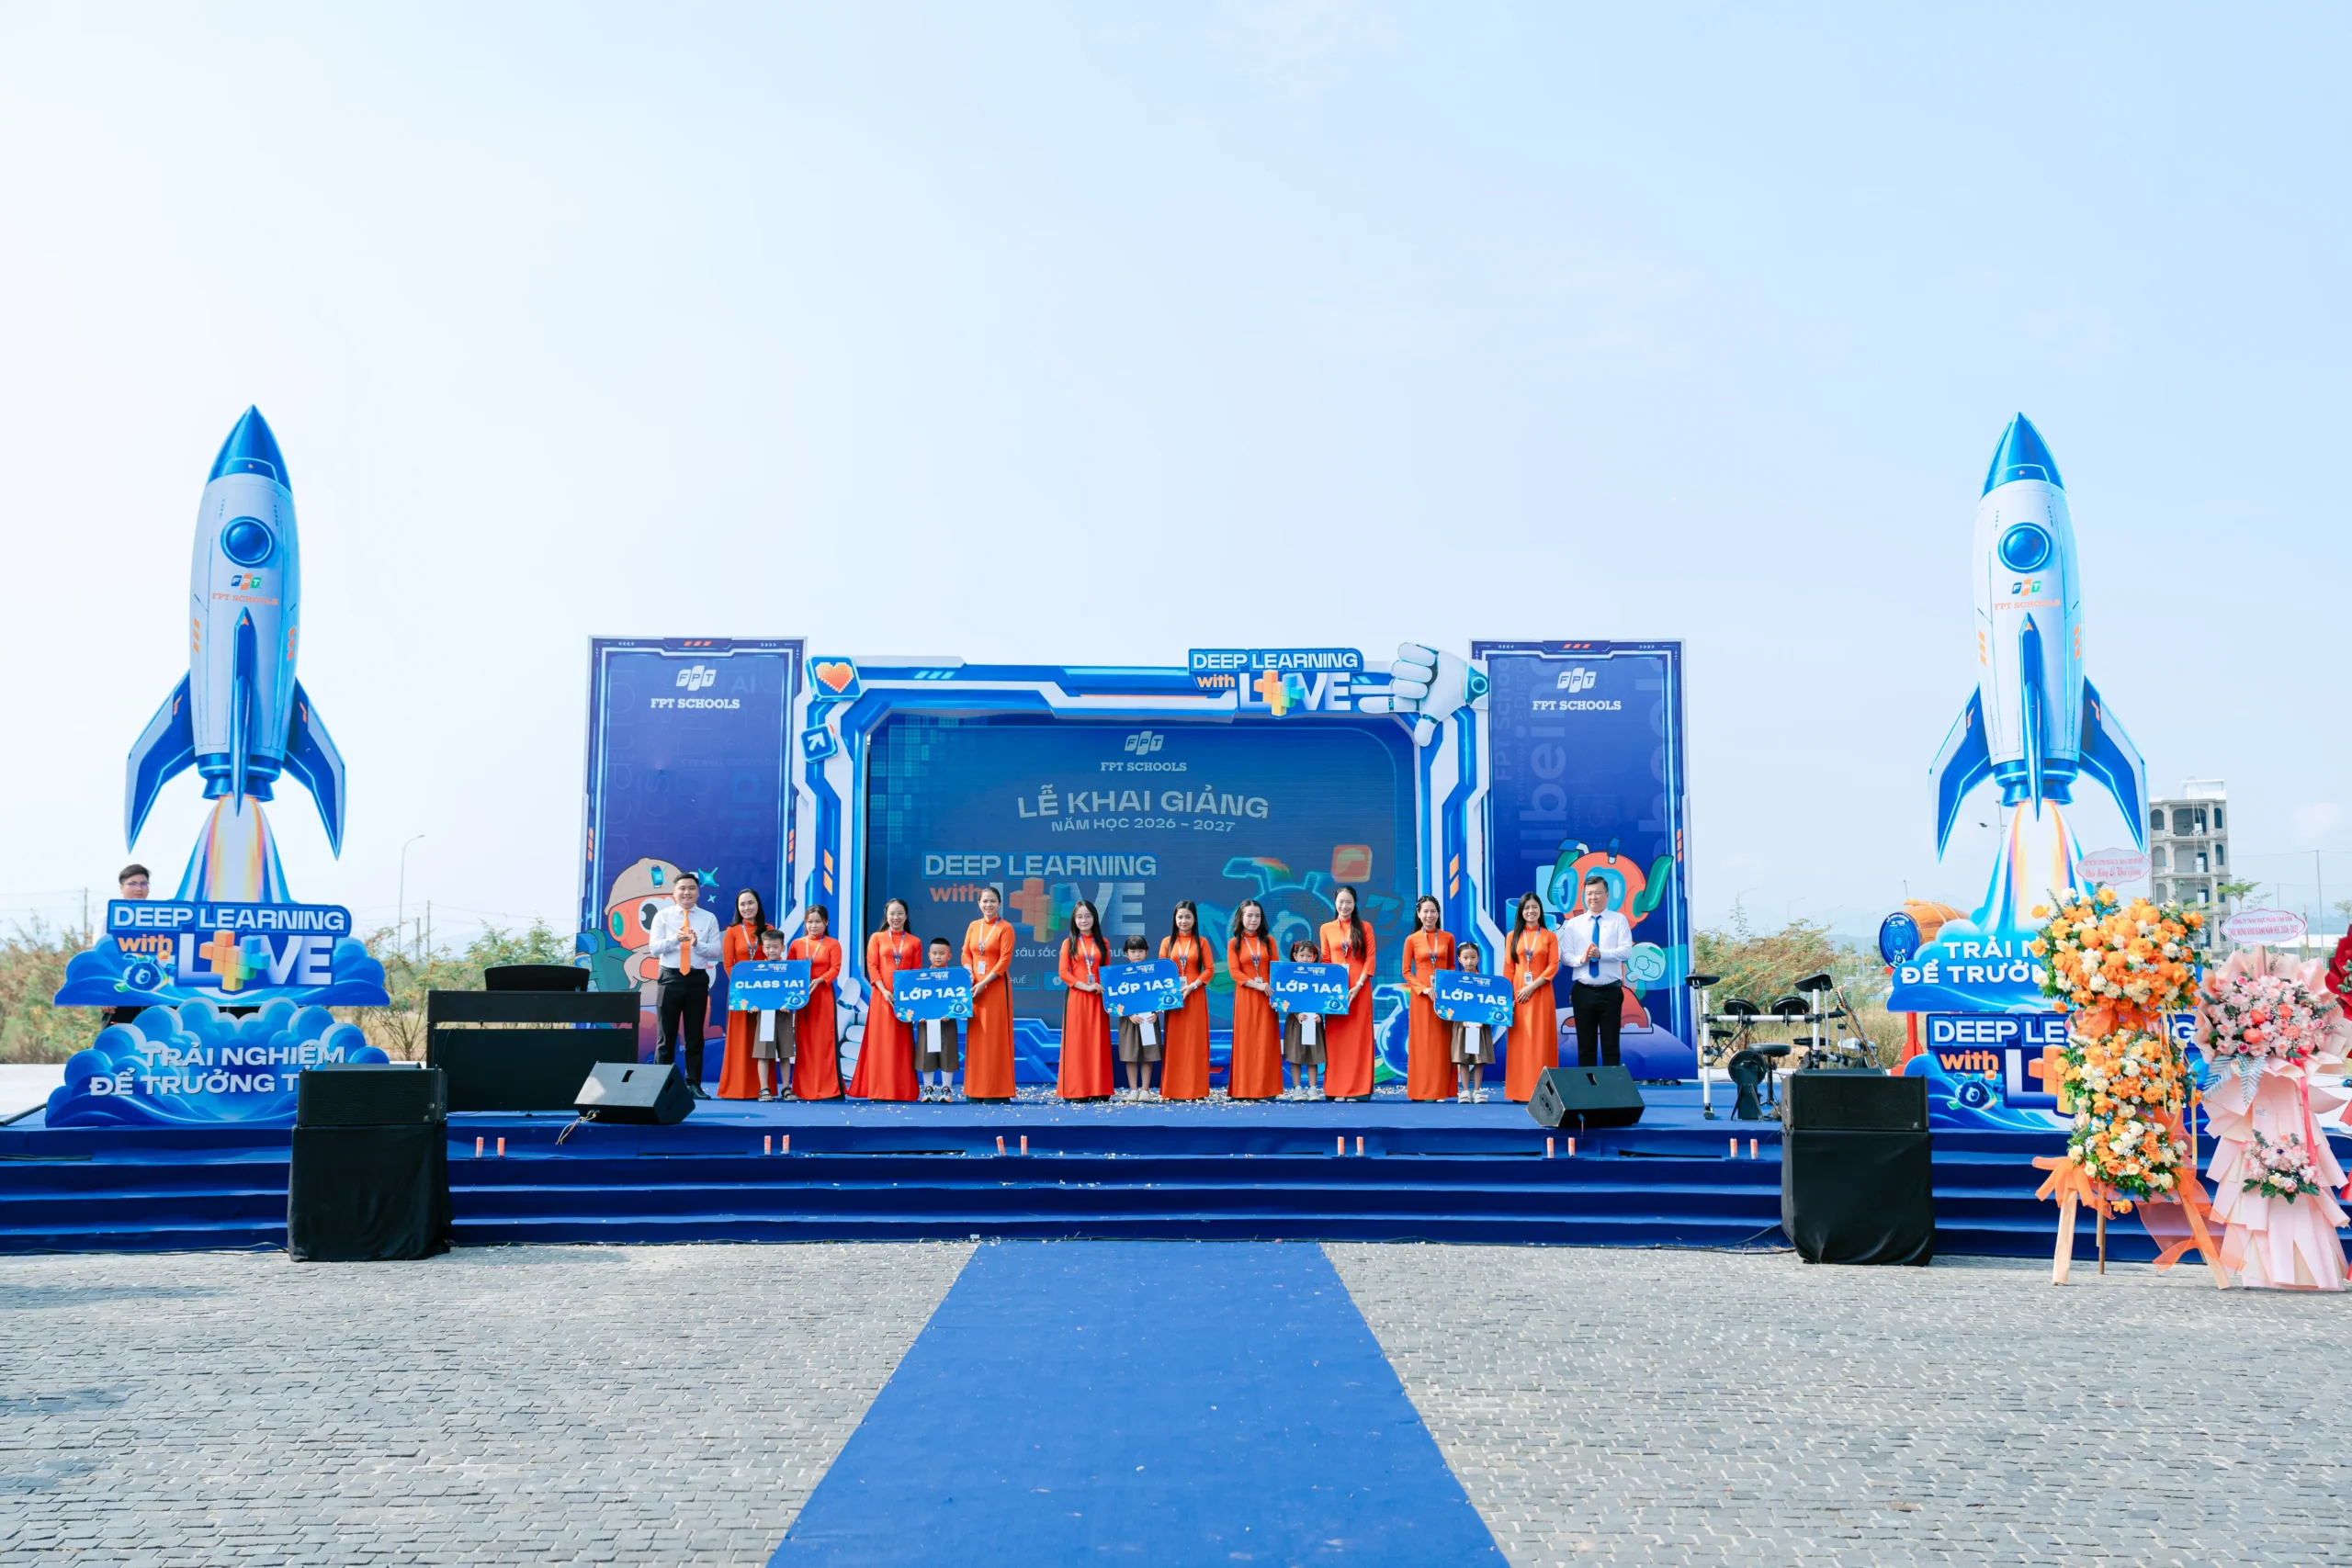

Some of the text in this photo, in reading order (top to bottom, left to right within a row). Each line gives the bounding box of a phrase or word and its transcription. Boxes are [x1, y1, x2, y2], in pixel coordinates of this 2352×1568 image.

[231, 573, 262, 591] FPT
[2011, 579, 2041, 596] FPT
[212, 592, 278, 606] FPT SCHOOLS
[1193, 652, 1358, 670] DEEP LEARNING
[675, 665, 717, 691] FPT
[1196, 673, 1236, 689] with
[1556, 667, 1597, 693] FPT
[650, 698, 741, 709] FPT SCHOOLS
[1532, 700, 1622, 711] FPT SCHOOLS
[1124, 731, 1165, 755] FPT
[1101, 761, 1187, 773] FPT SCHOOLS
[1018, 784, 1269, 819] LỄ KHAI GIẢNG
[1052, 817, 1090, 832] NĂM
[1094, 818, 1129, 832] HỌC
[1134, 818, 1176, 829] 2026
[1193, 819, 1236, 832] 2027
[925, 855, 1157, 876] DEEP LEARNING
[930, 883, 981, 902] with
[114, 906, 345, 931] DEEP LEARNING
[118, 933, 173, 955] with
[1014, 945, 1057, 957] sâu sắc
[1942, 935, 2012, 959] TRẢI
[1900, 958, 2045, 985] ĐỂ TRƯỞ
[735, 979, 804, 989] CLASS 1A1
[1108, 977, 1174, 997] LỚP 1A3
[1275, 979, 1342, 993] LỚP 1A4
[899, 987, 967, 1001] LỚP 1A2
[1441, 988, 1507, 1006] LỚP 1A5
[1933, 1020, 2012, 1043] DEEP
[141, 1042, 345, 1069] TRẢI NGHIỆM
[1939, 1049, 1999, 1071] with
[89, 1067, 134, 1097] ĐỂ
[140, 1068, 276, 1095] TRƯỞNG
